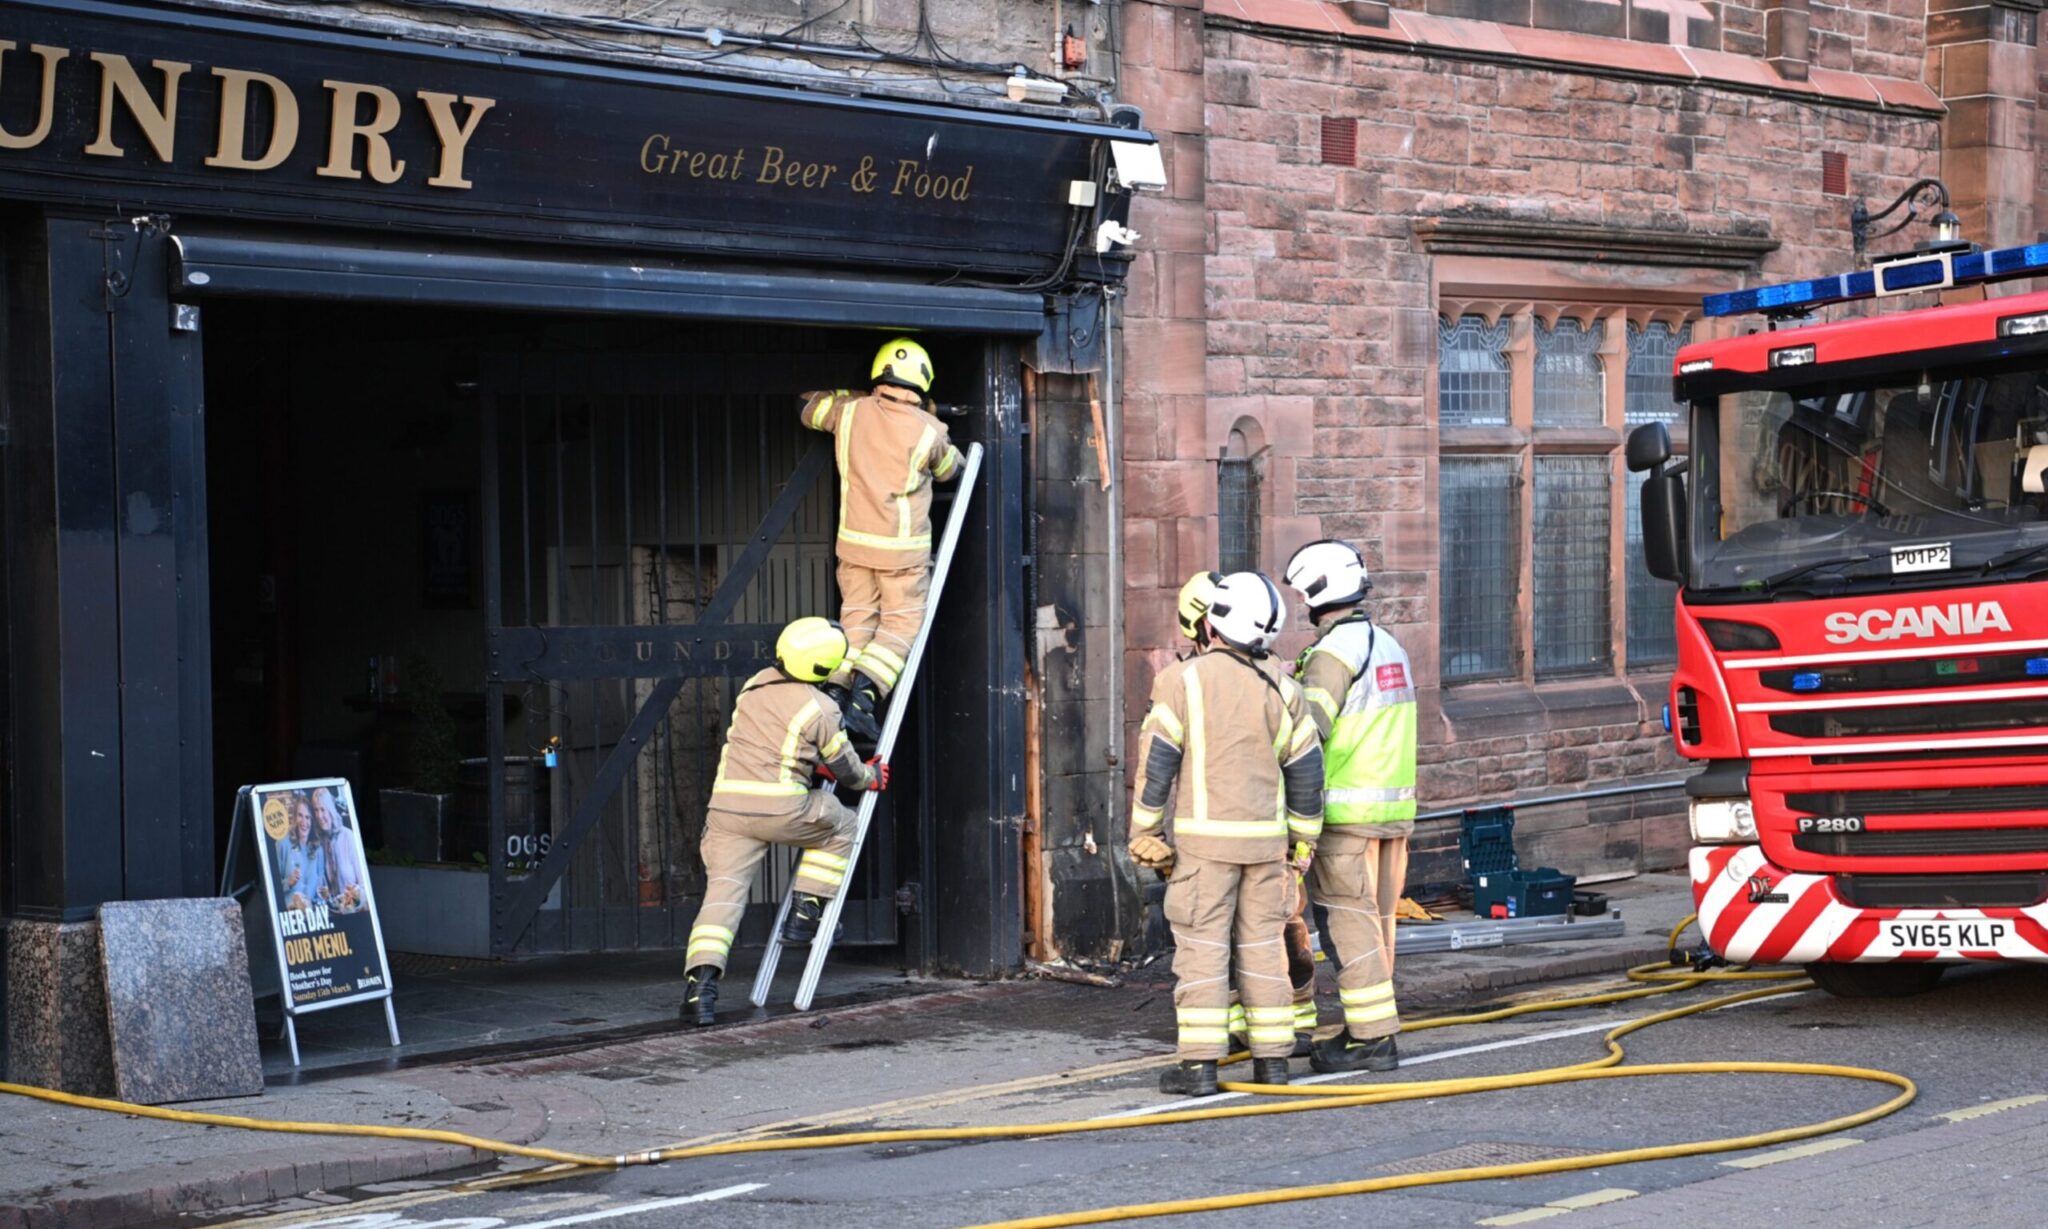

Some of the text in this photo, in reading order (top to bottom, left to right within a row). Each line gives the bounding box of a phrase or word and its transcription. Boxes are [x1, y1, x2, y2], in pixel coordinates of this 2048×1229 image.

[0, 40, 496, 189] UNDRY
[639, 133, 974, 202] Great Beer & Food
[1824, 601, 2012, 645] SCANIA
[1799, 816, 1860, 833] P 280
[279, 909, 306, 936] HER
[1890, 924, 2005, 947] SV65 KLP
[285, 931, 352, 966] OUR MENU.
